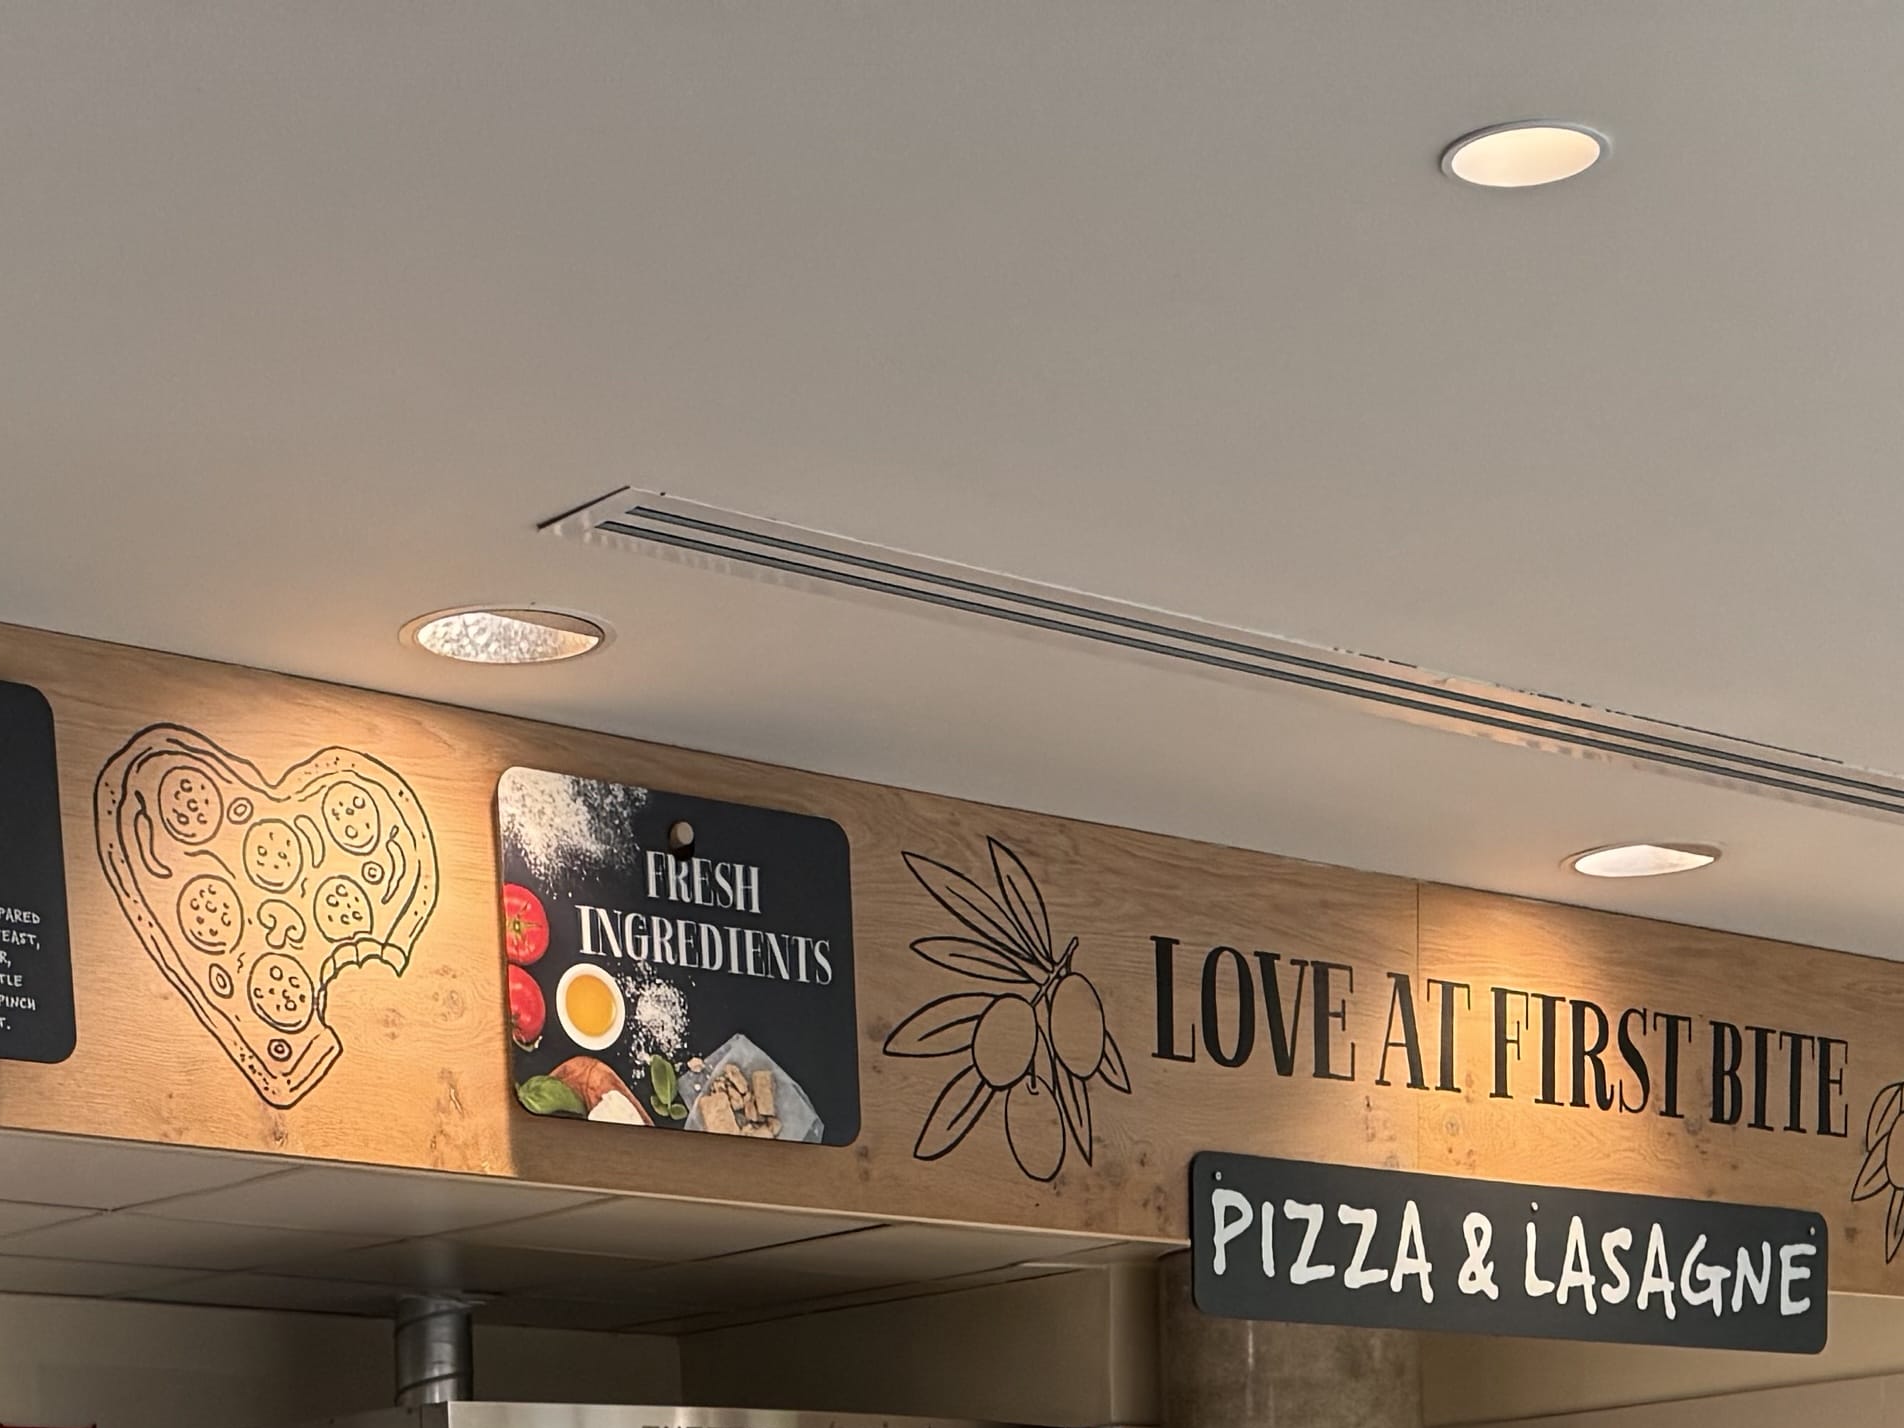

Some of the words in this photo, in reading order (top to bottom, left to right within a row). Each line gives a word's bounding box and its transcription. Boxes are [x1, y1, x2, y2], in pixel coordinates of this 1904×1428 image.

[645, 850, 762, 914] FRESH
[575, 904, 834, 986] INGREDIENTS
[1149, 935, 1356, 1083] LOVE
[1375, 971, 1472, 1094] AT
[1489, 986, 1692, 1119] FIRST
[1710, 1019, 1850, 1139] BITE
[1210, 1187, 1435, 1304] PIZZA
[1457, 1211, 1500, 1300] &
[1523, 1215, 1817, 1321] LASAGNE
